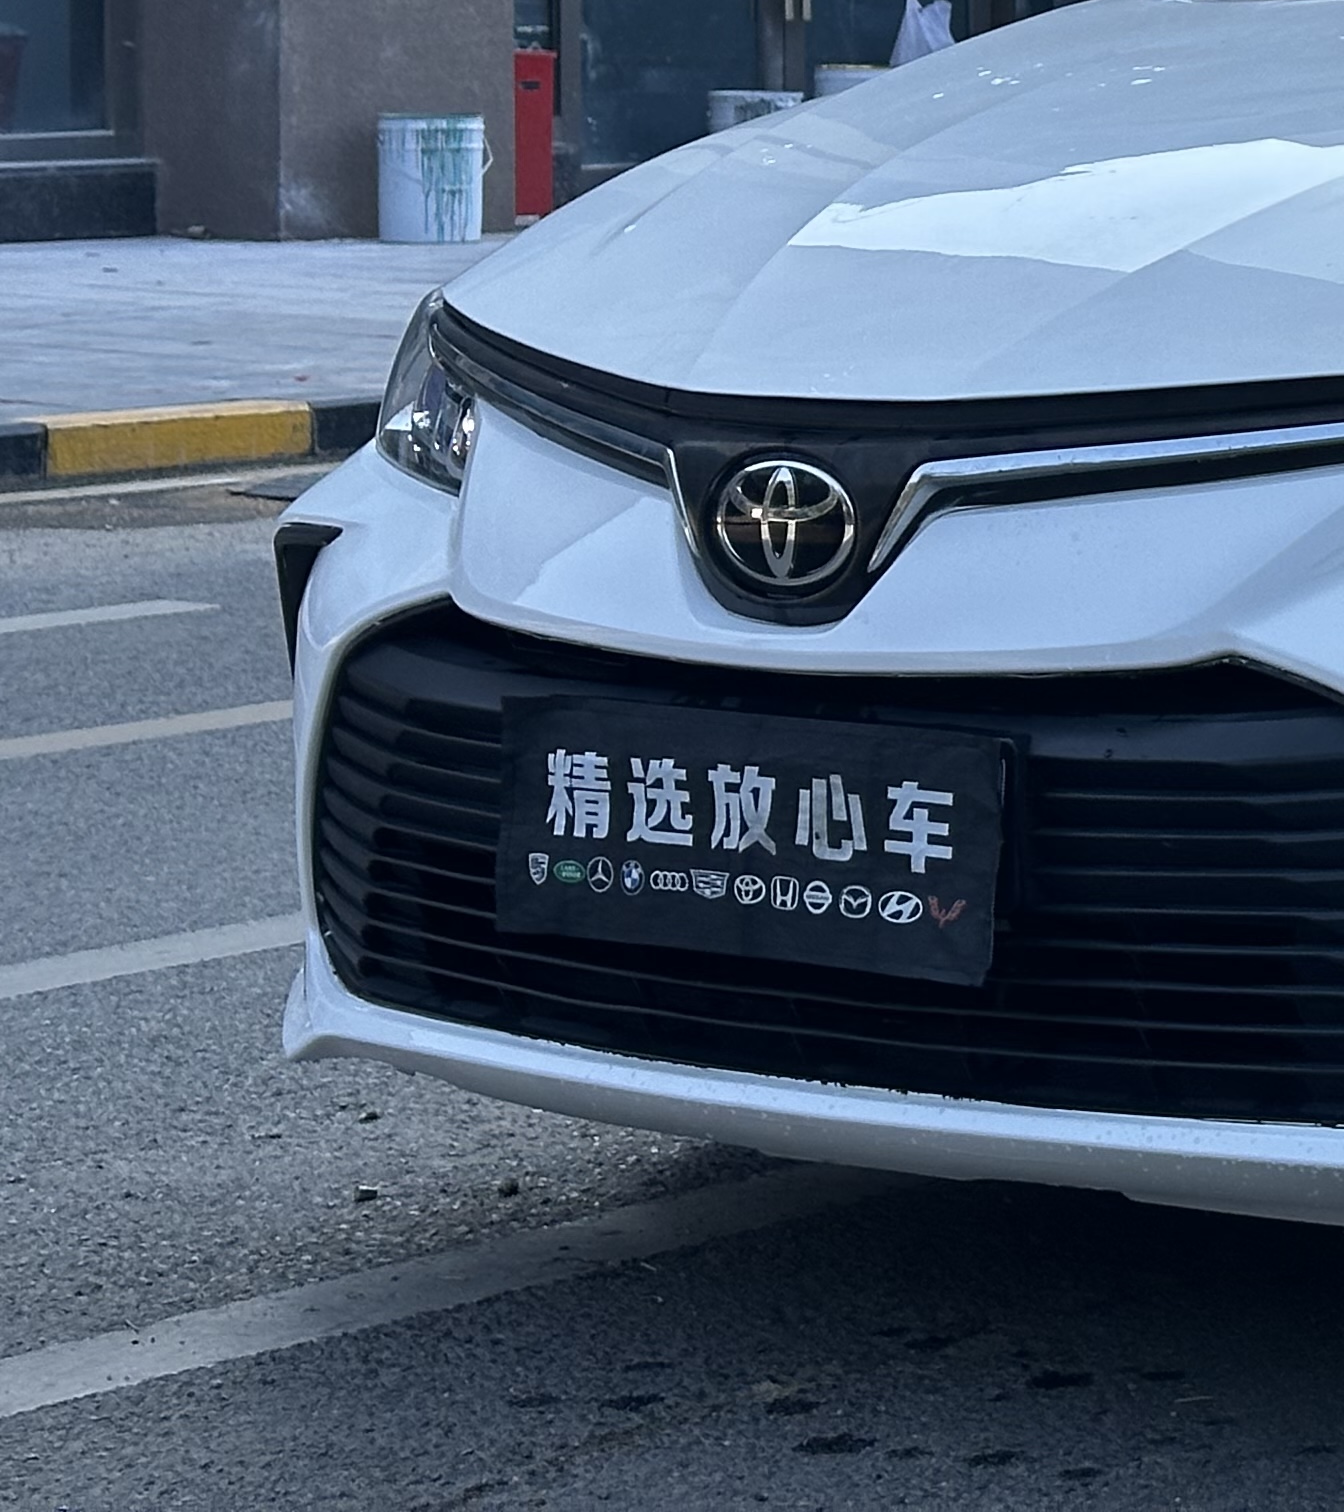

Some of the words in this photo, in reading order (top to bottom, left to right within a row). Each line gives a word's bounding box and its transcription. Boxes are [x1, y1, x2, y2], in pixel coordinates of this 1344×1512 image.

[546, 748, 955, 874] 精选放心车
